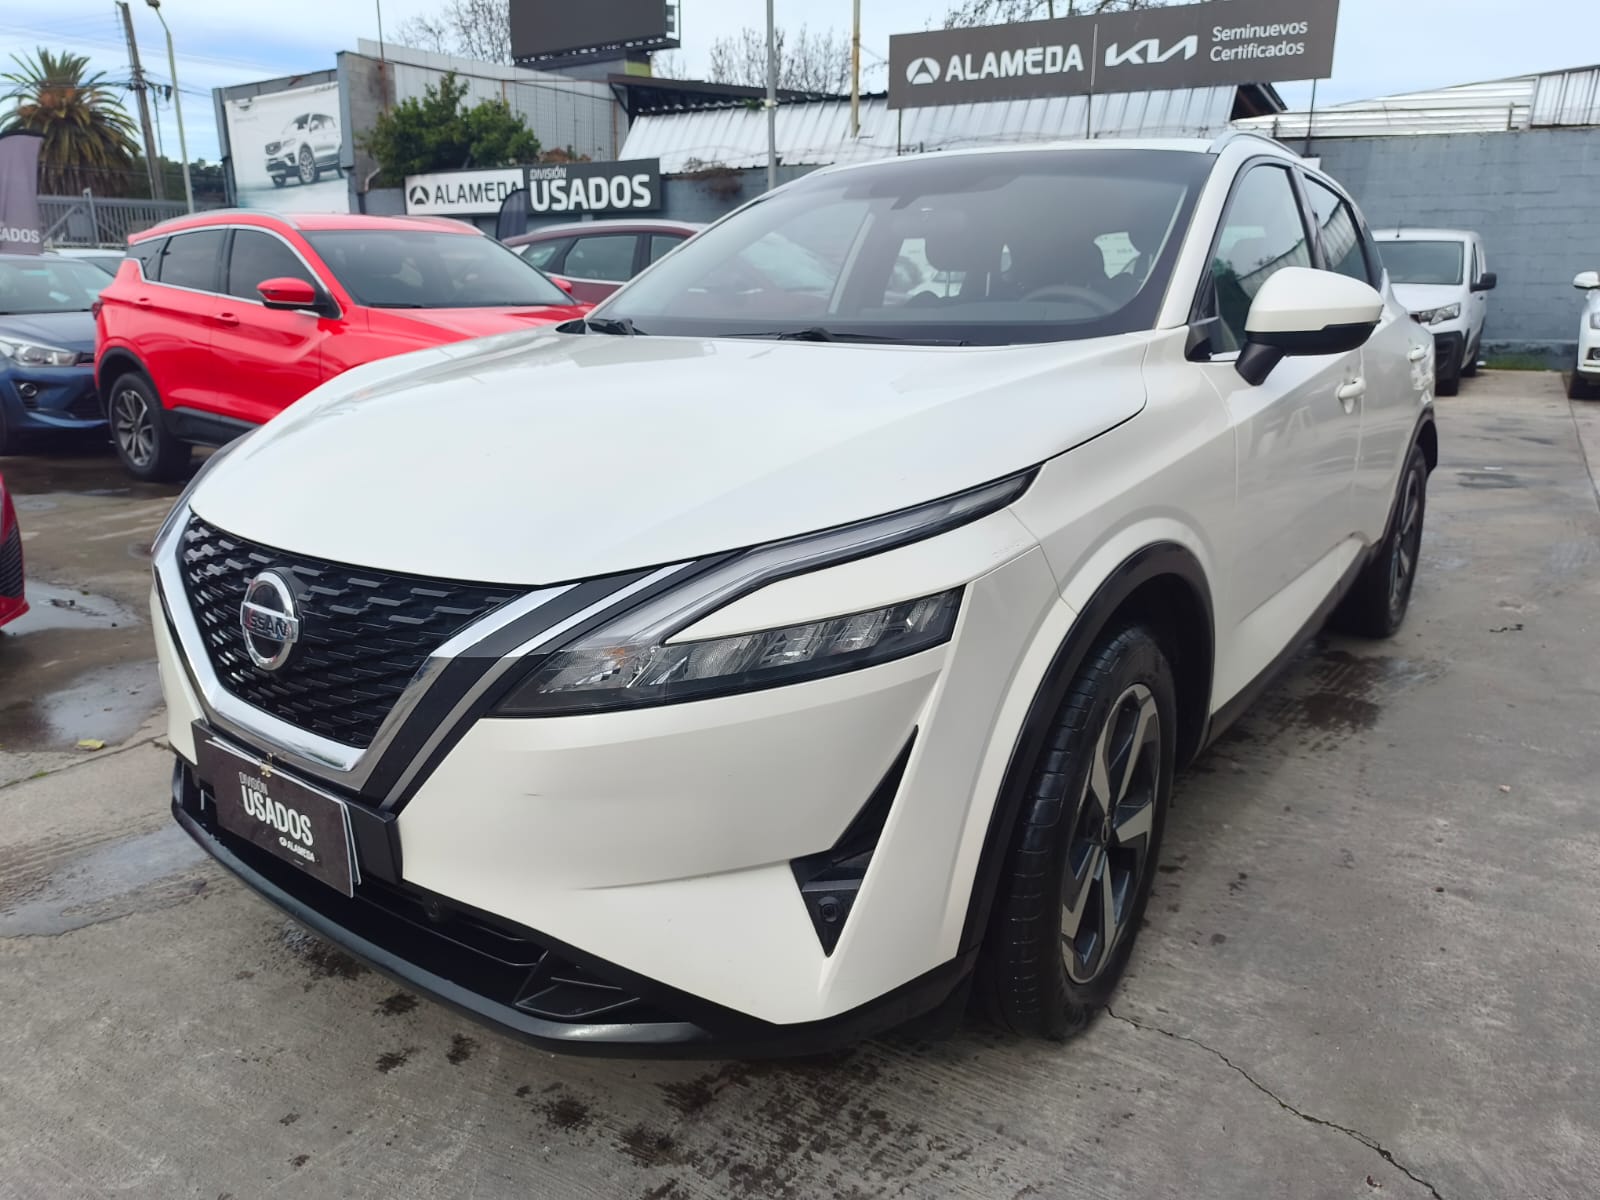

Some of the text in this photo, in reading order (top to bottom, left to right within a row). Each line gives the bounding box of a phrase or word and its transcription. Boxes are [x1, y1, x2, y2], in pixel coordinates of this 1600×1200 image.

[1212, 21, 1308, 41] Seminuevos
[945, 44, 1085, 82] ALAMEDA
[1210, 40, 1305, 62] Certificados
[530, 165, 566, 180] DIVISIÓN
[530, 174, 651, 211] USADOS
[0, 227, 40, 244] ADOS
[244, 609, 289, 637] SSAN
[239, 771, 268, 796] DIVISIÓN
[241, 785, 314, 846] USADOS
[287, 840, 315, 863] ALAMEDA
